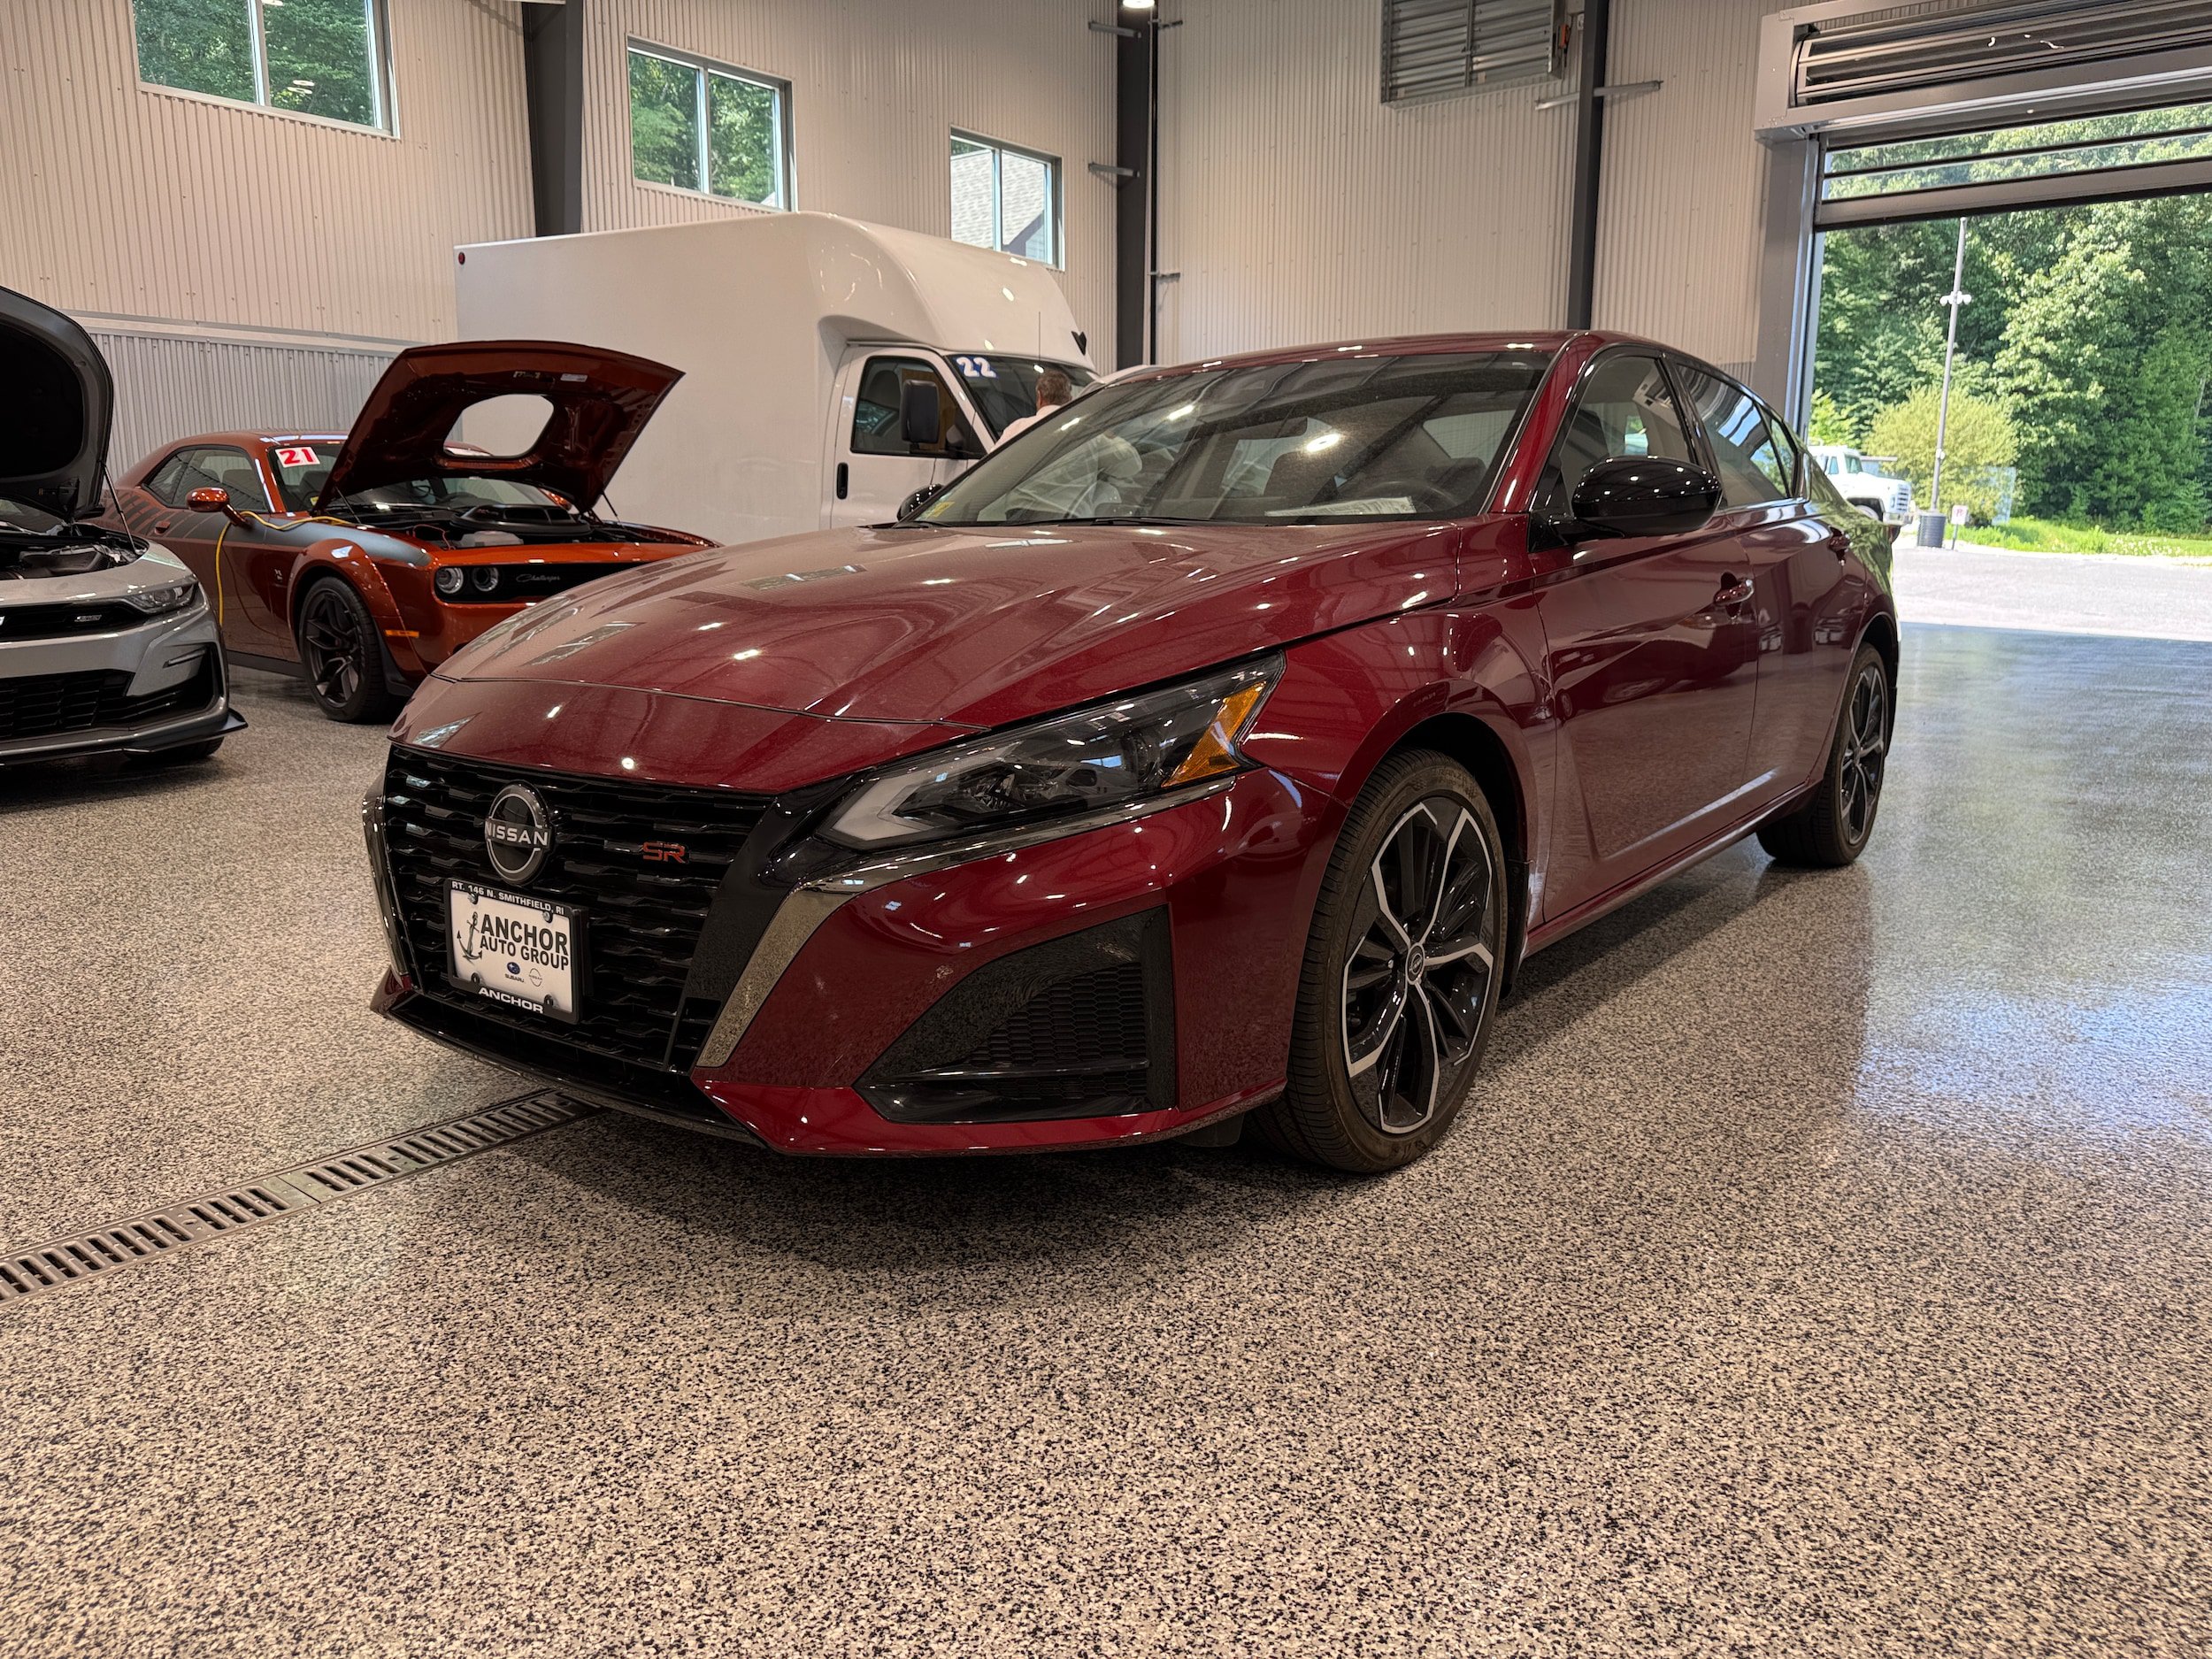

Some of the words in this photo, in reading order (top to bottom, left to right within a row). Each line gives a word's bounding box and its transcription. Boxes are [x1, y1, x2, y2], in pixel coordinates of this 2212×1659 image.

[956, 357, 997, 378] 22
[279, 449, 314, 465] 21
[485, 820, 549, 846] NISSAN
[642, 841, 686, 864] SR
[451, 880, 465, 891] RT.
[468, 885, 485, 895] 146
[487, 889, 496, 898] N.
[498, 892, 554, 913] SMITHFIELD,
[556, 905, 565, 915] RI
[480, 914, 569, 956] ANCHOR
[480, 935, 516, 956] AUTO
[520, 946, 569, 971] GROUP
[478, 987, 544, 1014] ANCHOR
